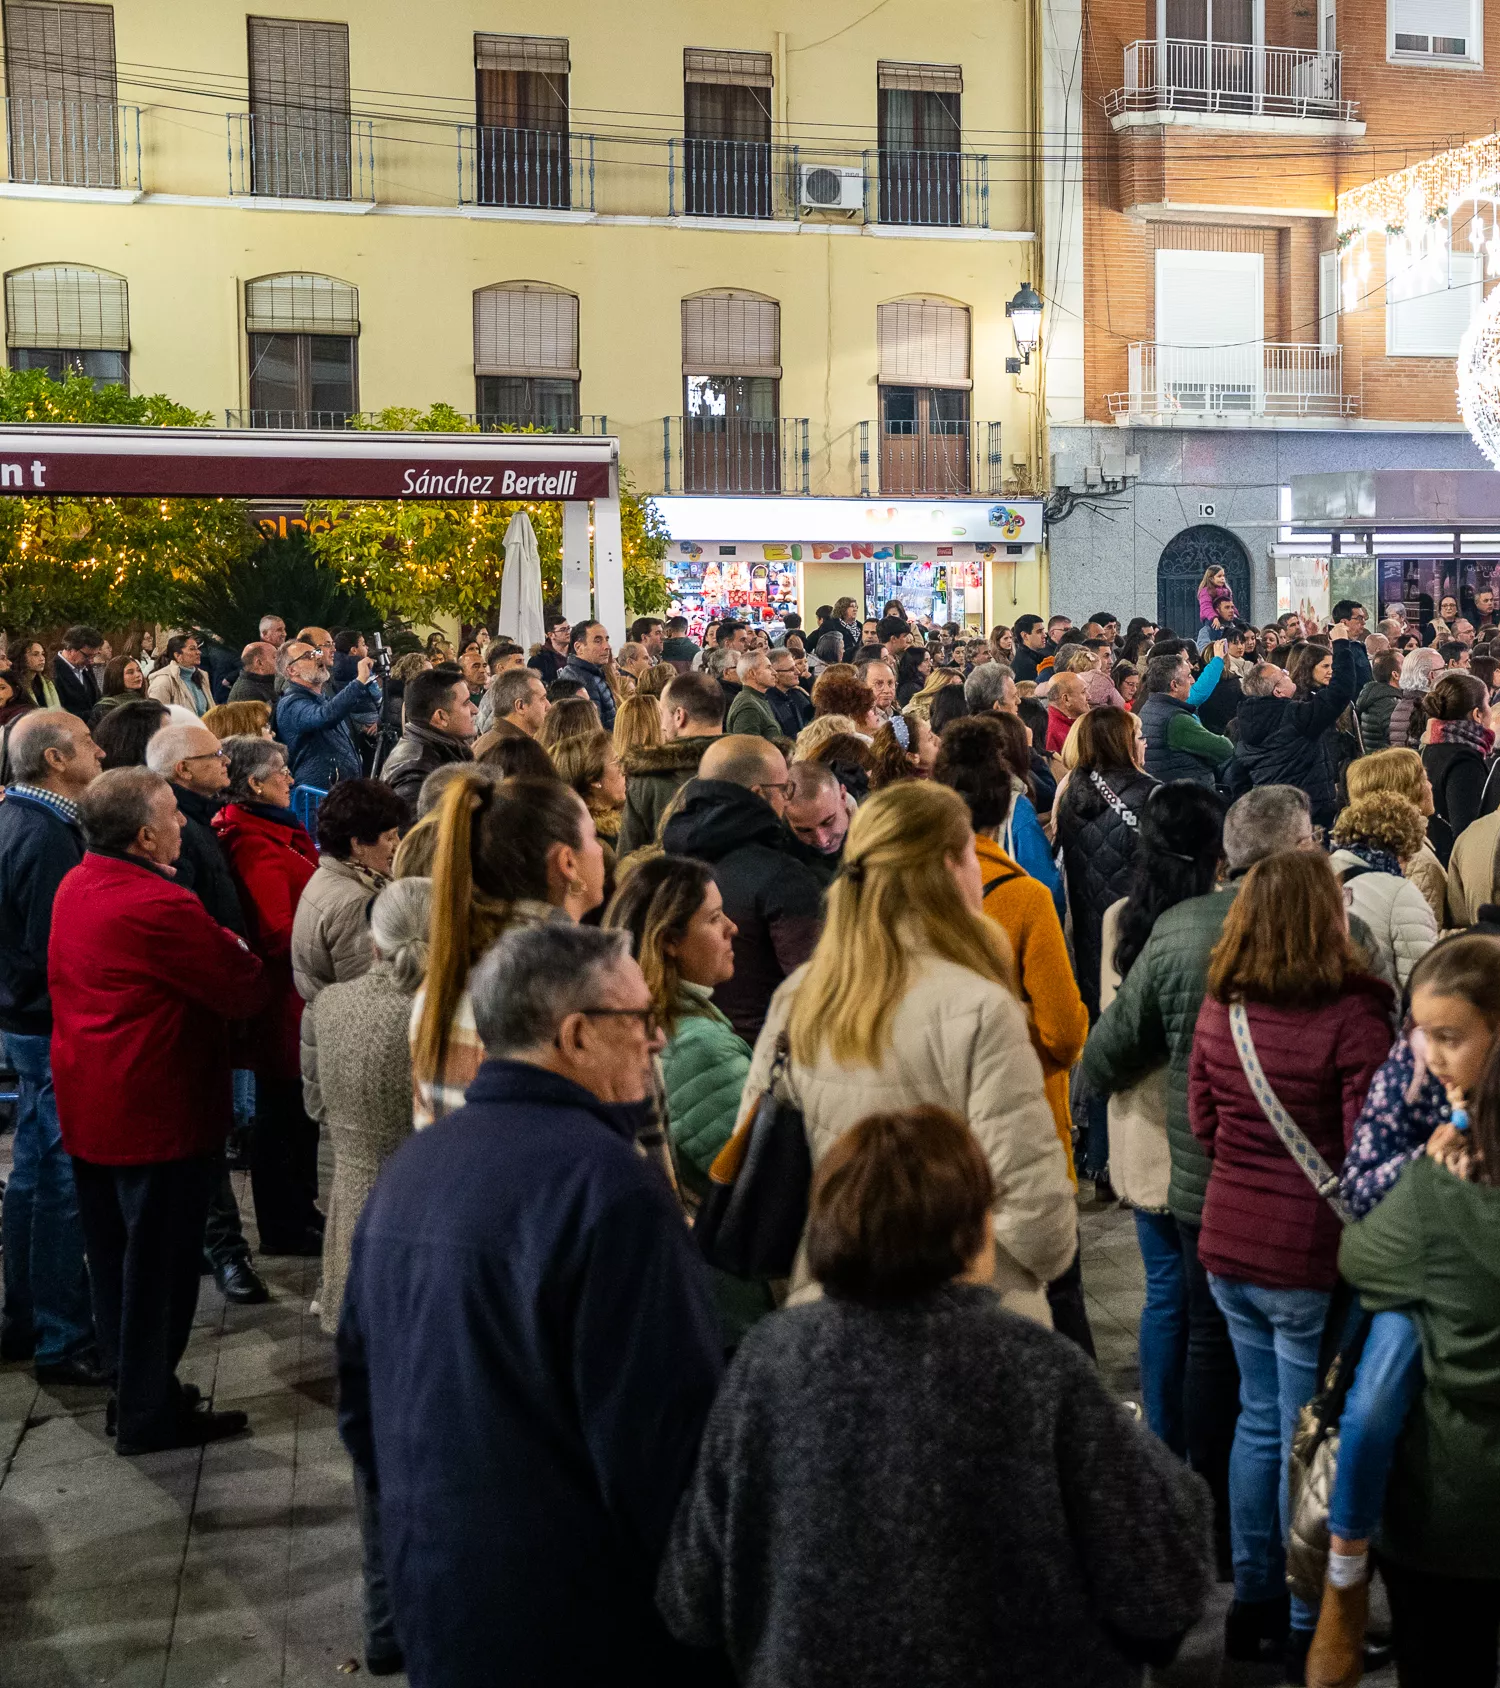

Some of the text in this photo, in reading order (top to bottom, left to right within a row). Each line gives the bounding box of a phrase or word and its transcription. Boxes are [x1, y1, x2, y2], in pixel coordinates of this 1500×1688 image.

[402, 468, 578, 496] Sánchez Bertelli
[1199, 504, 1214, 516] 10
